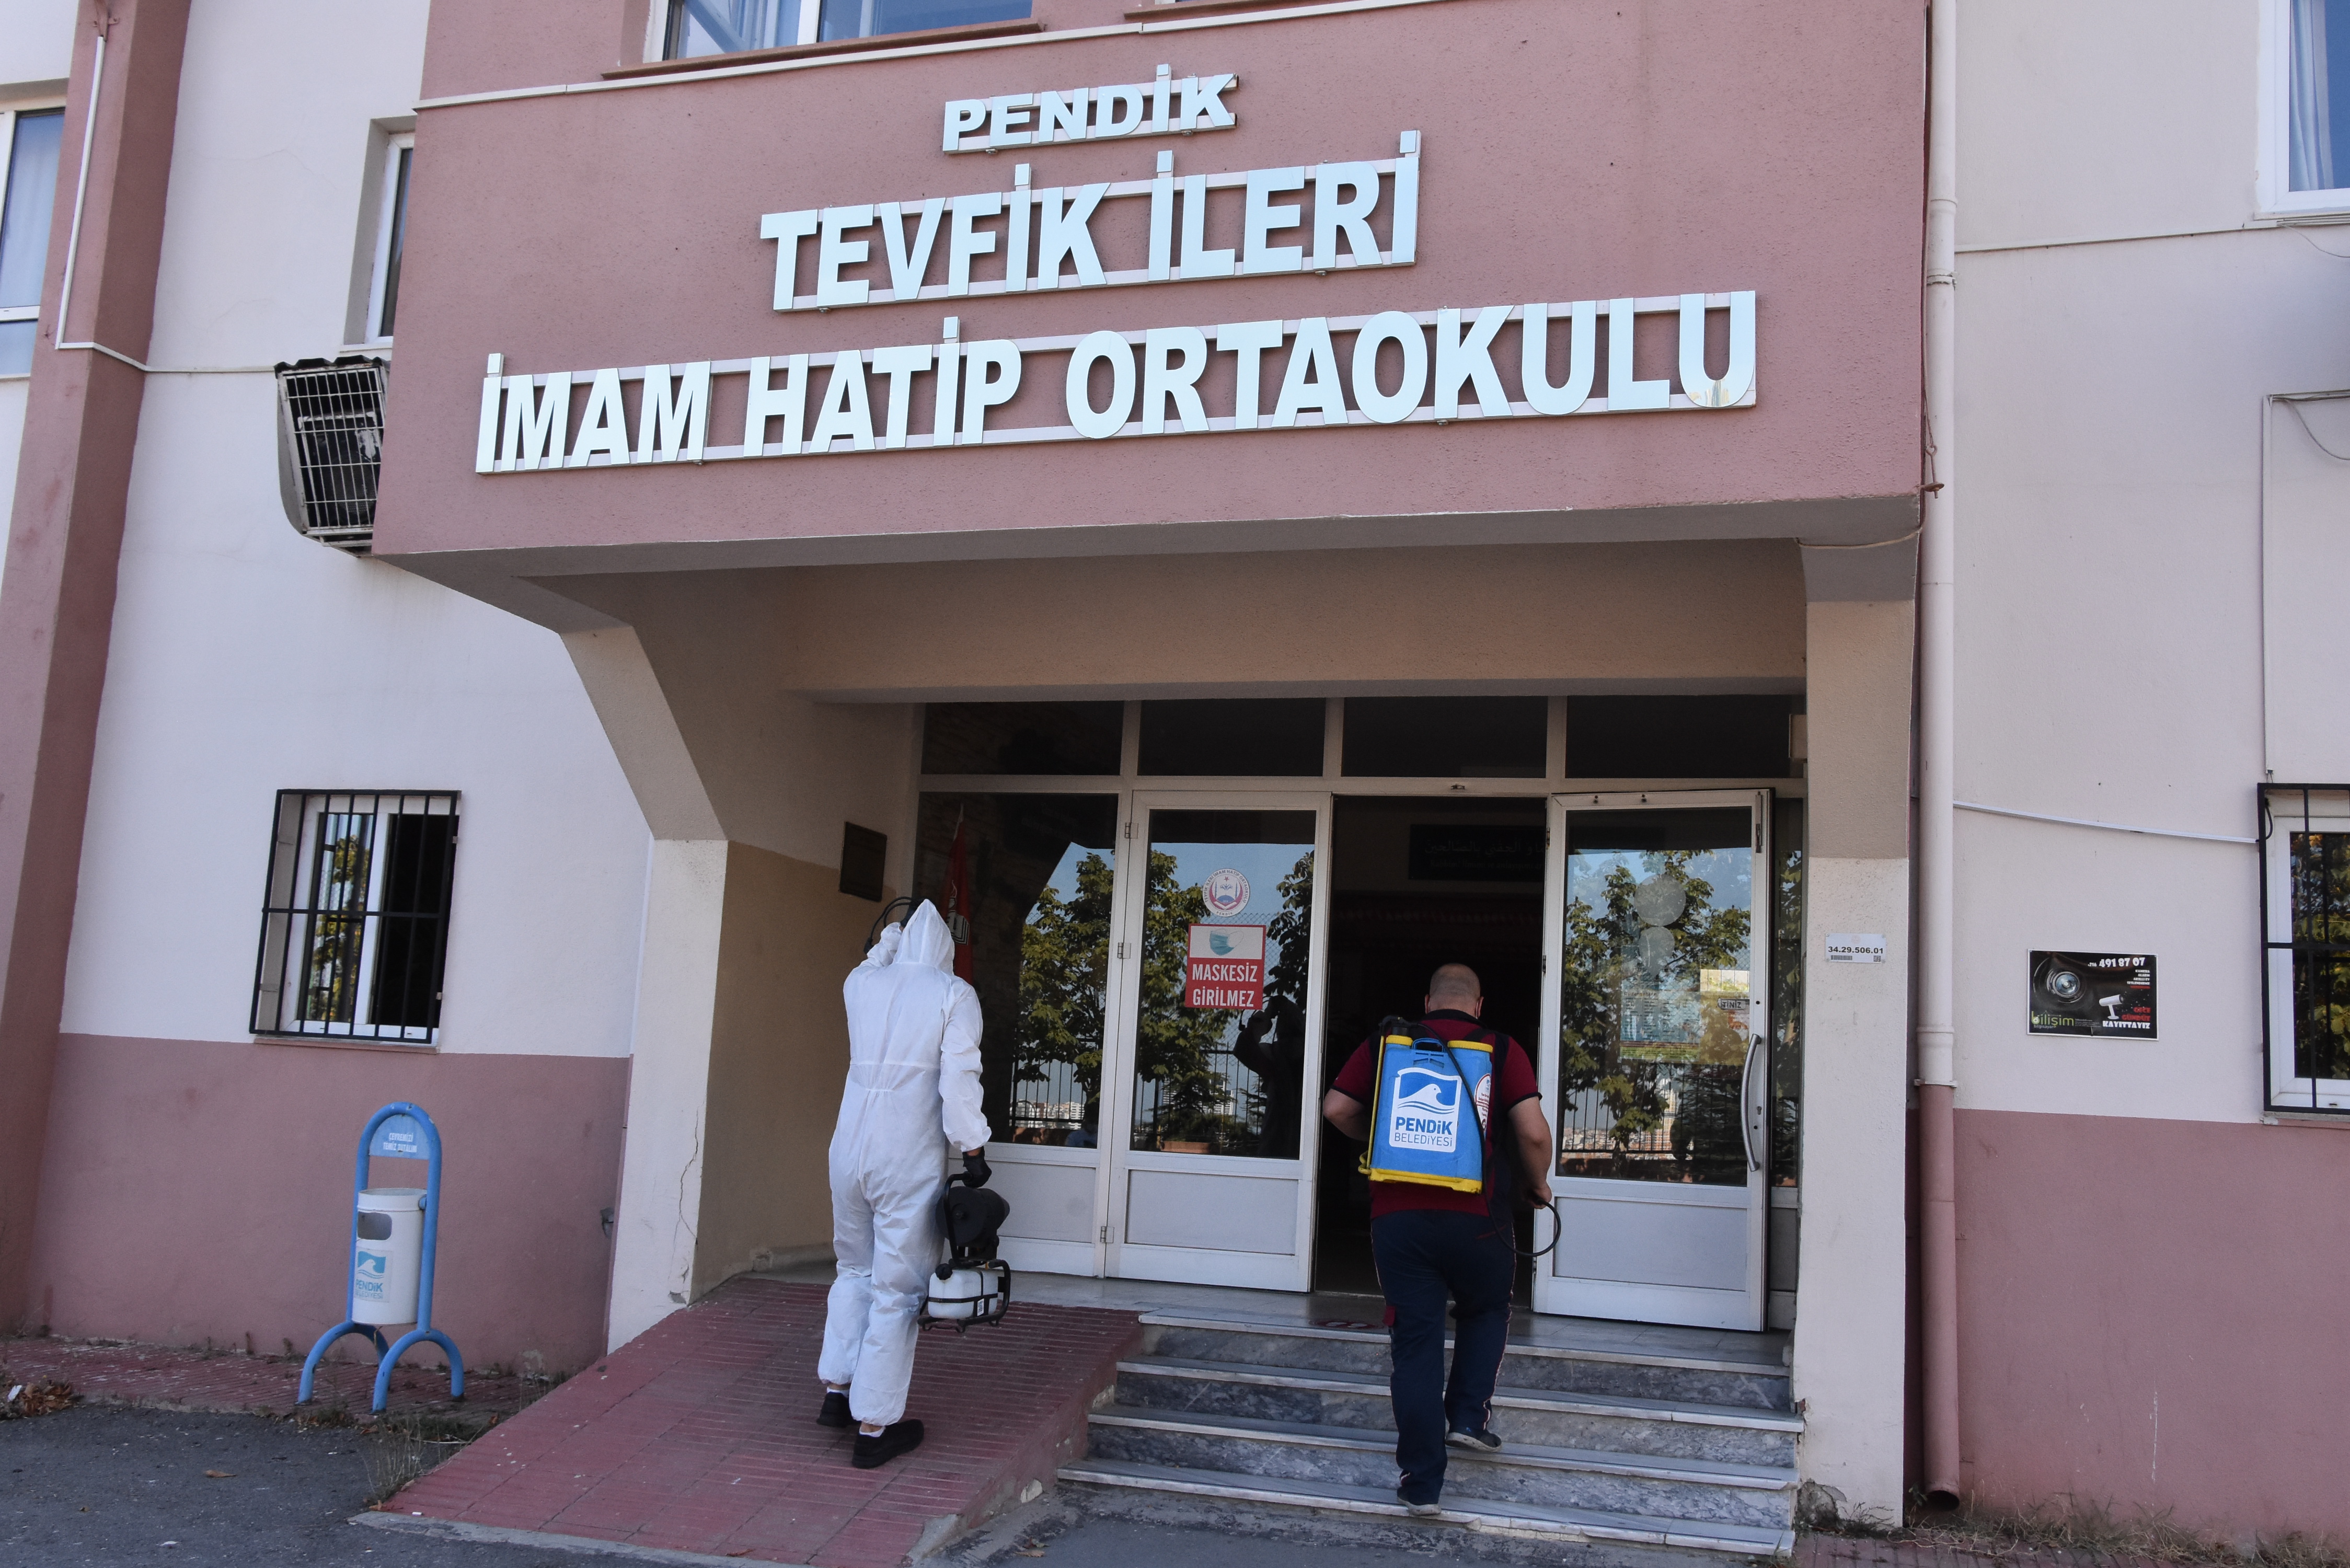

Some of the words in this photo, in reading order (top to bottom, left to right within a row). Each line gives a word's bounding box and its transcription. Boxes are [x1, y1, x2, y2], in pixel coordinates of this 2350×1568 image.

[943, 63, 1237, 152] PENDİK
[760, 163, 1111, 310] TEVFİK
[1148, 130, 1419, 281] İLERİ
[476, 353, 711, 473] İMAM
[743, 316, 1022, 457] HATİP
[1065, 290, 1756, 438] ORTAOKULU
[1192, 962, 1258, 982] MASKESİZ
[2099, 958, 2116, 967] 491
[2118, 958, 2130, 967] 87
[2133, 957, 2145, 966] 07
[1193, 986, 1254, 1007] GİRİLMEZ
[2031, 1011, 2074, 1028] bilişim
